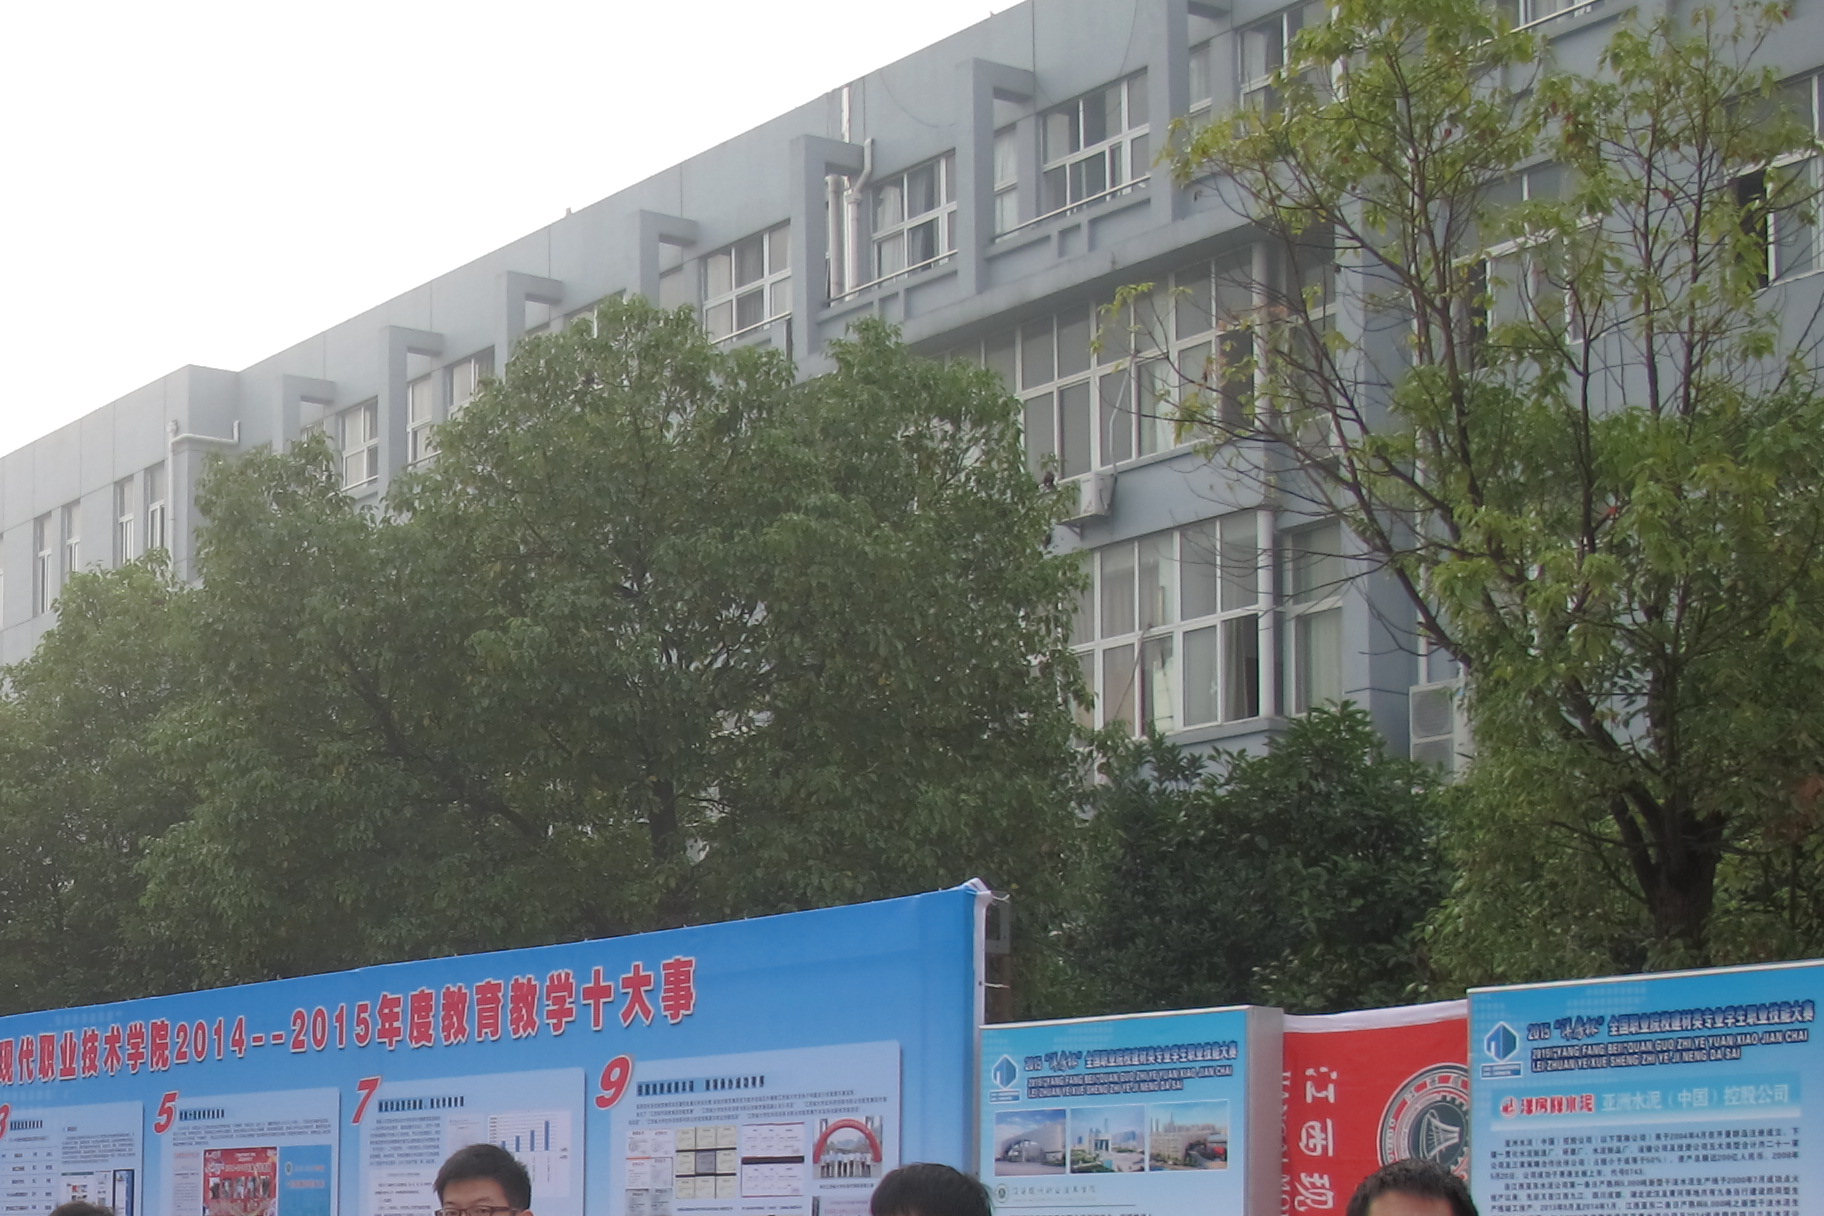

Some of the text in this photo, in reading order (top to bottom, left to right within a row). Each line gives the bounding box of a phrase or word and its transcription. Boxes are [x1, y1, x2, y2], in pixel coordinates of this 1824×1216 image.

[351, 1075, 383, 1126] 7
[595, 1054, 634, 1110] 9
[153, 1090, 179, 1134] 5
